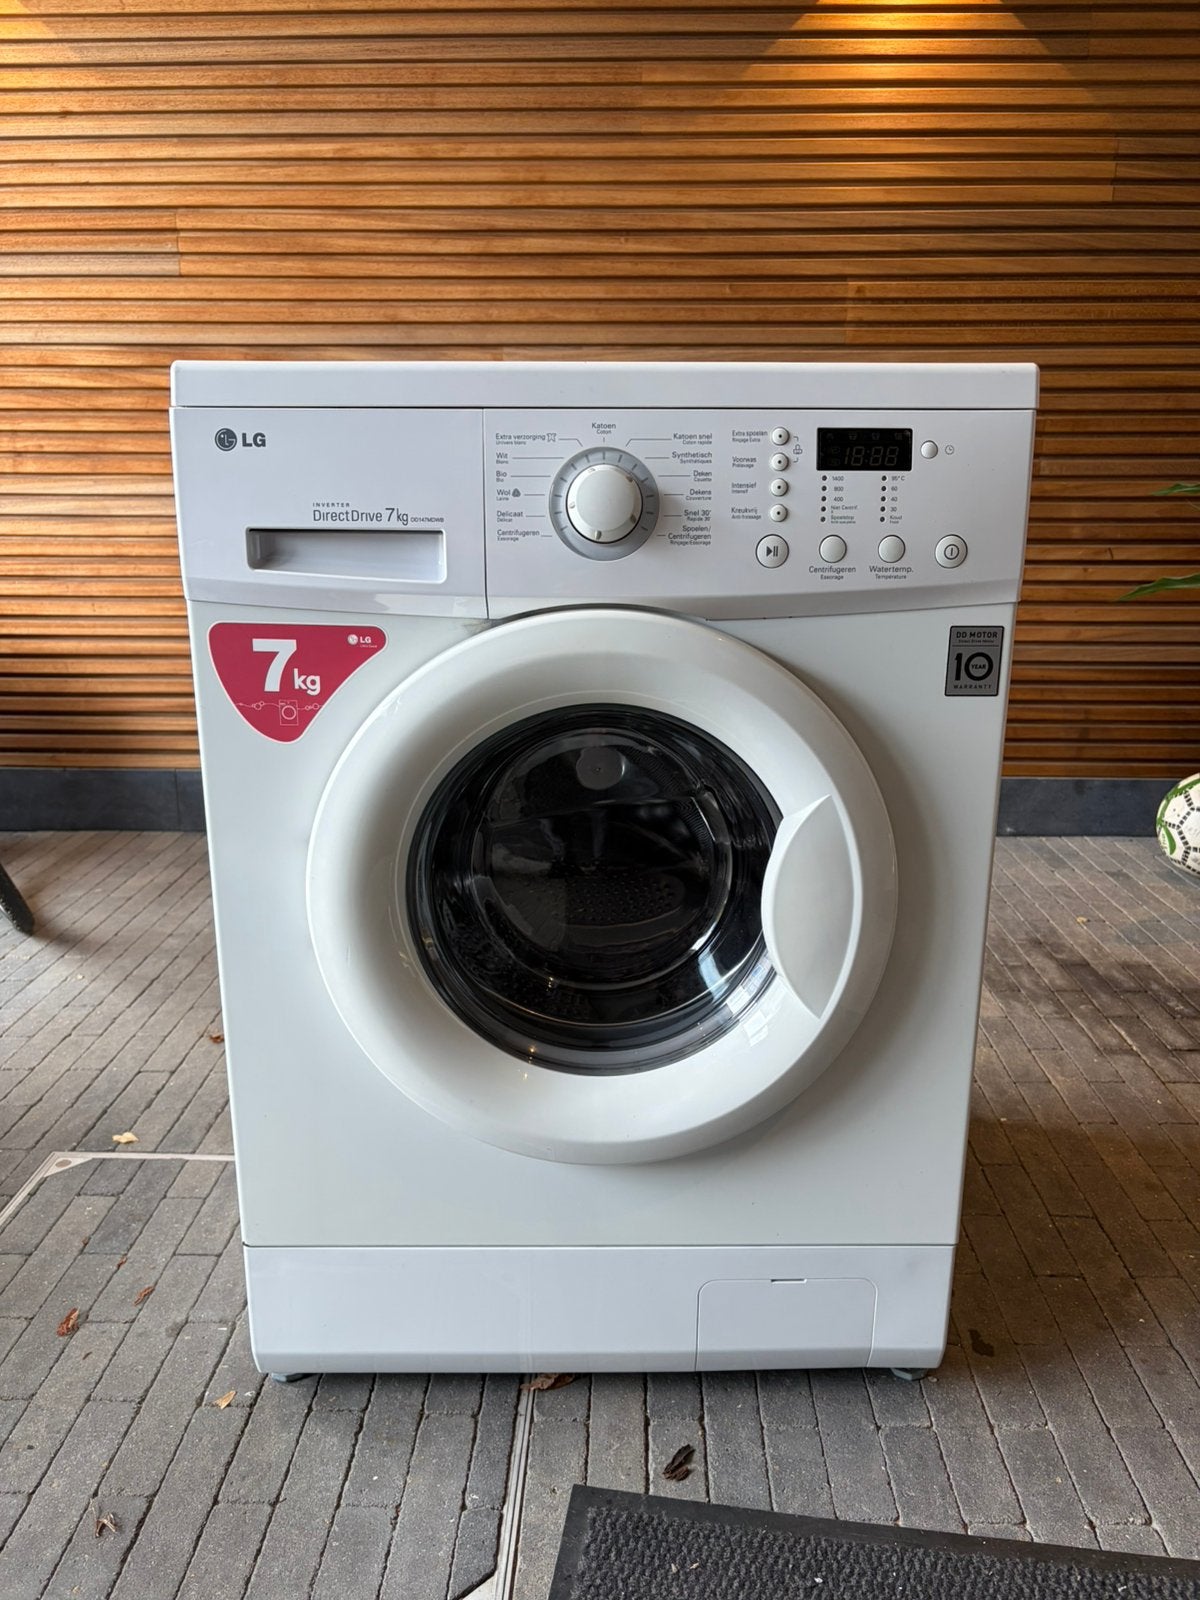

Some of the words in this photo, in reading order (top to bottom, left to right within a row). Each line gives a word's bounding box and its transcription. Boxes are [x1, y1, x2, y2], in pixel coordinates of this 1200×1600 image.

[591, 422, 617, 430] Katoen
[495, 432, 512, 440] Extra
[513, 433, 546, 442] verzorging
[673, 432, 697, 440] Katoen
[732, 429, 745, 437] Extra
[746, 430, 768, 438] spoelen
[241, 432, 266, 448] LG
[671, 450, 713, 459] Synthetisch
[496, 488, 511, 496] Wol
[496, 510, 523, 518] Delicaat
[683, 509, 700, 517] Snel
[731, 507, 758, 515] Kreukvrij
[496, 529, 540, 537] Centrifugeren
[682, 525, 712, 533] Spoelen/
[667, 532, 712, 541] Centrifugeren
[808, 565, 856, 574] Centrifugeren
[868, 565, 914, 574] Watertemp.
[956, 631, 967, 639] DD
[969, 631, 998, 639] MOTOR
[360, 635, 372, 644] LG
[954, 651, 994, 681] 10
